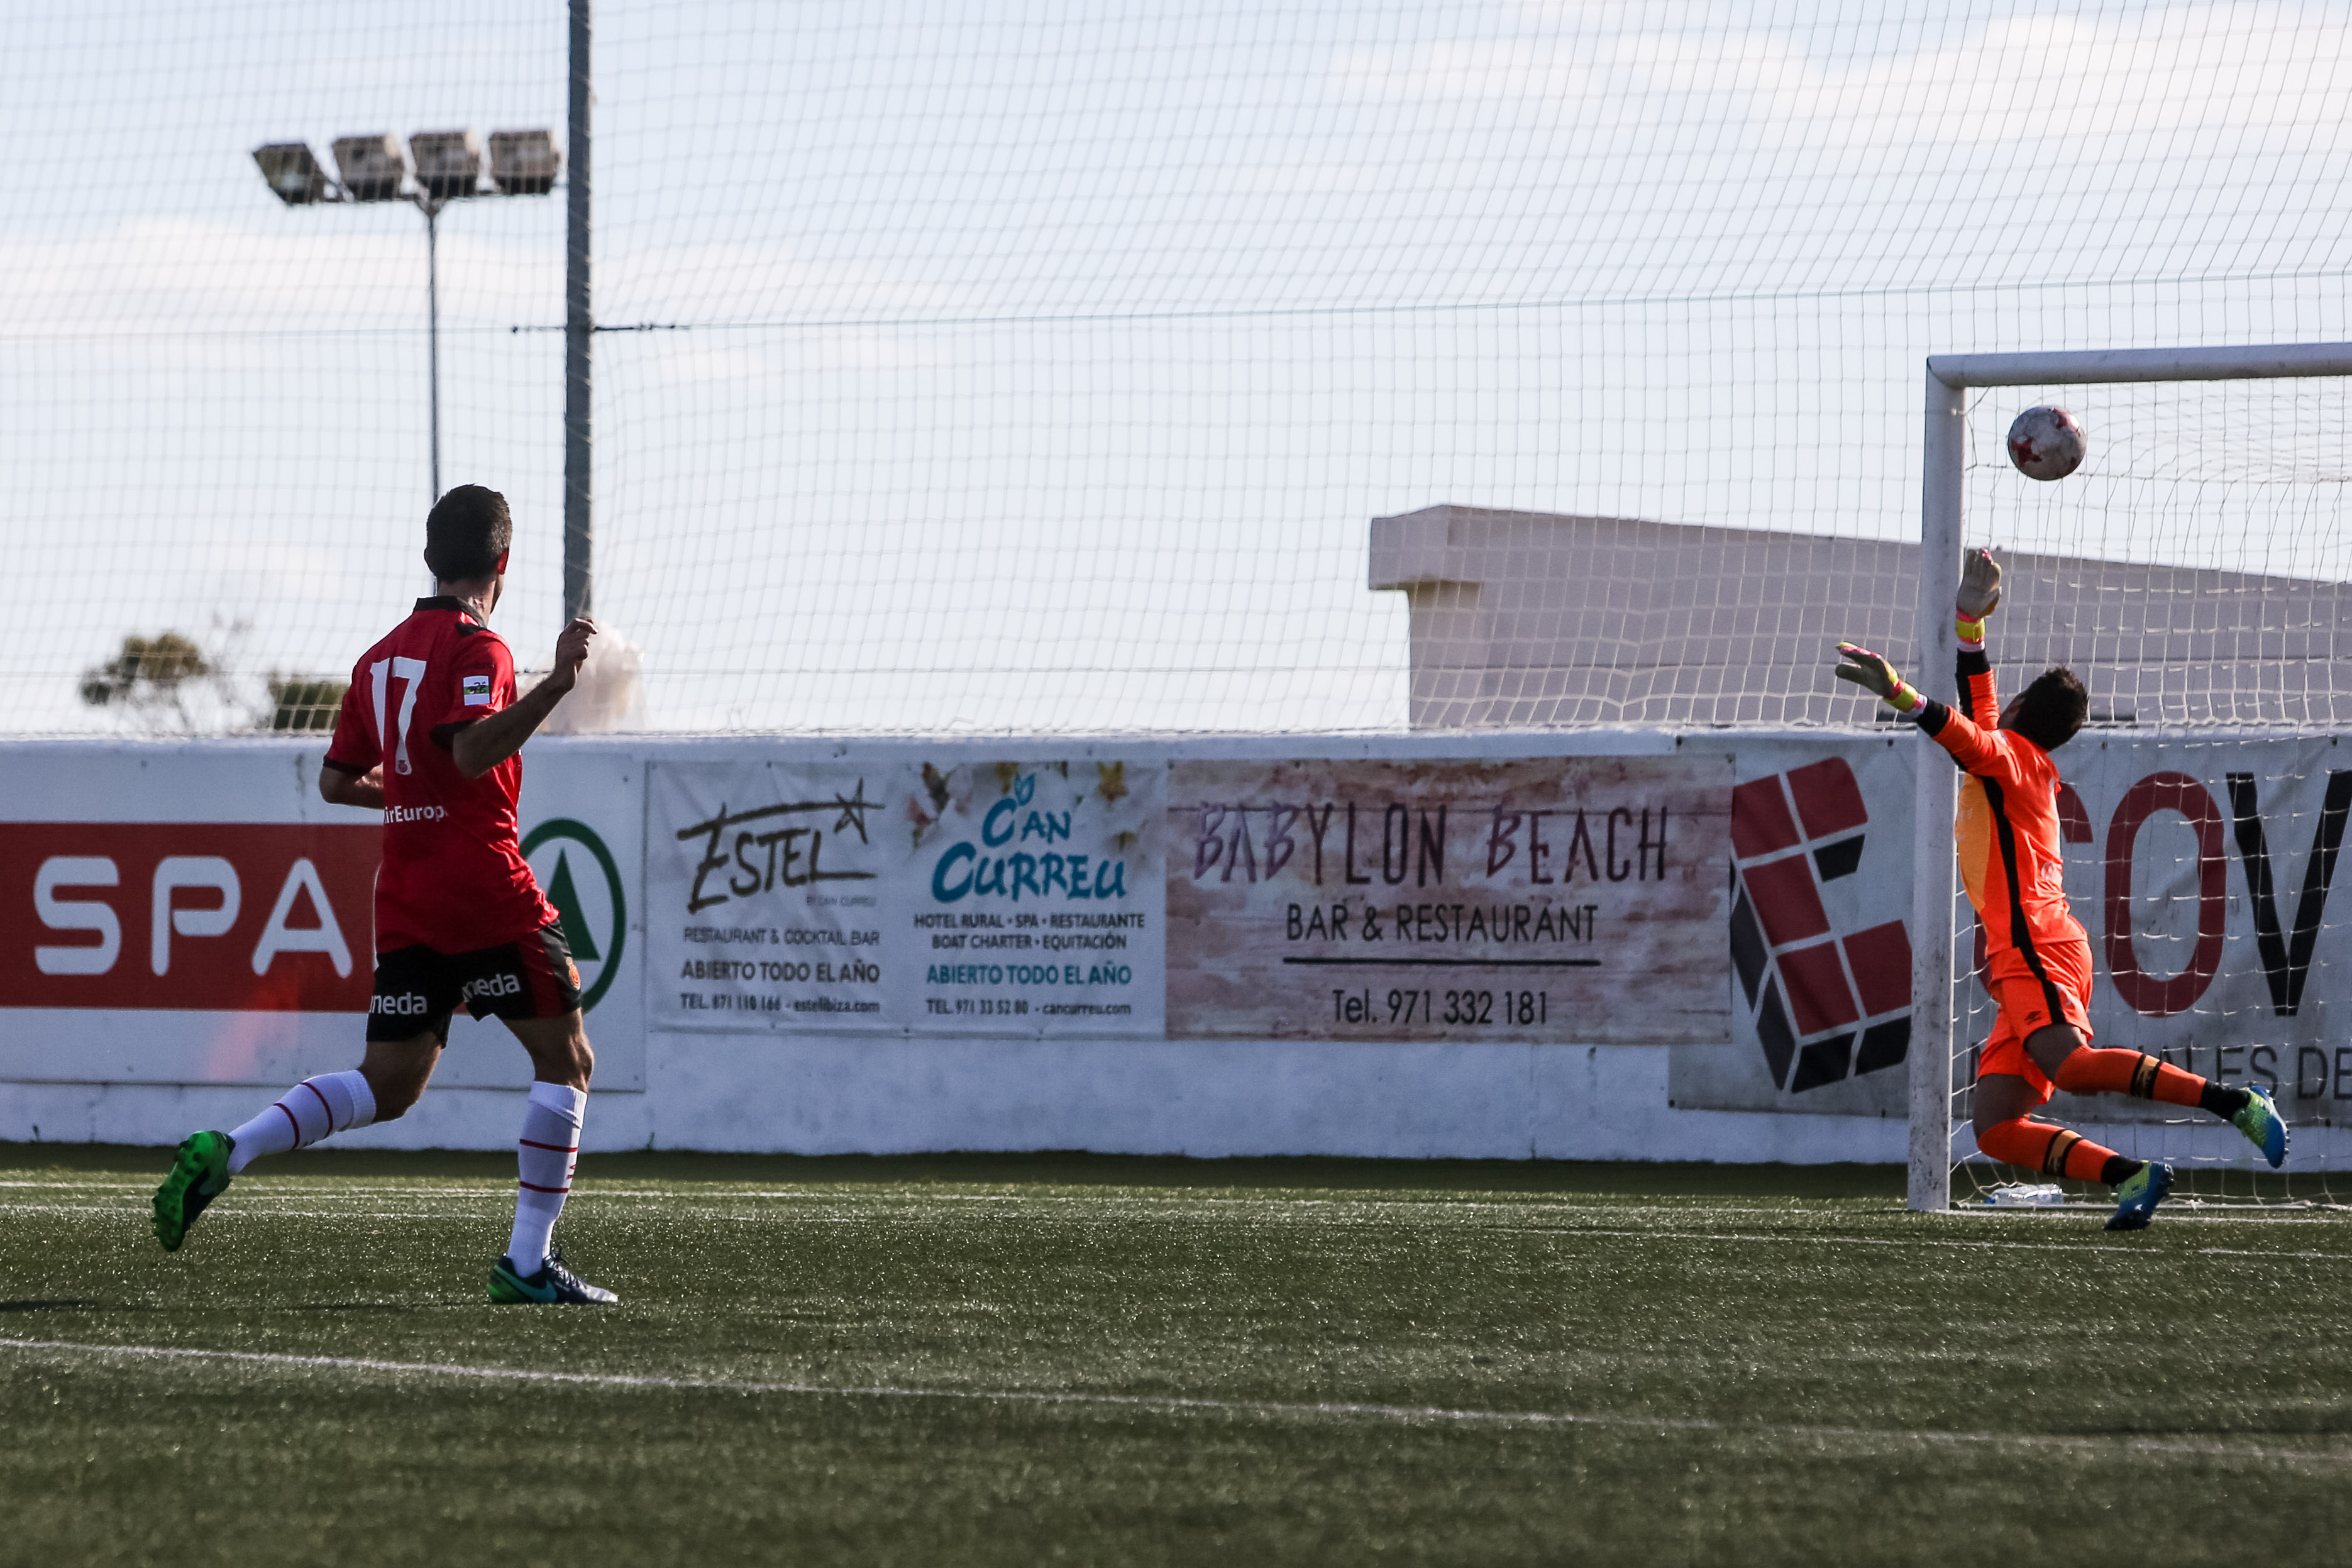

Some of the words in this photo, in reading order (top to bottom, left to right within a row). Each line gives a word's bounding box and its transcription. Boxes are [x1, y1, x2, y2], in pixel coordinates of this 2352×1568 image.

[370, 656, 427, 775] 17
[384, 804, 448, 824] irEurop
[981, 797, 1071, 847] CAN
[677, 802, 881, 915] ESTEL
[1194, 801, 1447, 888] BABYLON
[1486, 802, 1669, 885] BEACH
[931, 841, 1127, 903] CURREU
[1974, 770, 2352, 1019] OV
[33, 855, 382, 978] SPA
[914, 913, 958, 929] HOTEL
[961, 913, 1005, 929] RURAL
[1015, 913, 1039, 929] SPA
[1050, 912, 1145, 929] RESTAURANTE
[1286, 903, 1349, 942] BAR
[1361, 903, 1384, 942] &
[1396, 903, 1599, 943] RESTAURANT
[683, 926, 767, 944] RESTAURANT
[784, 928, 846, 946] COCKTAIL
[851, 929, 880, 946] BAR
[932, 933, 966, 950] BOAT
[969, 934, 1032, 950] CHARTER
[1042, 930, 1127, 951] EQUITACIÓN
[462, 973, 521, 1003] neda
[681, 959, 756, 981] ABIERTO
[759, 961, 811, 983] TODO
[816, 963, 836, 983] EL
[839, 958, 880, 983] AÑO
[926, 964, 1003, 985] ABIERTO
[1007, 964, 1059, 985] TODO
[1065, 966, 1085, 986] EL
[1088, 959, 1132, 986] AÑO
[369, 991, 428, 1015] neda
[1332, 988, 1378, 1025] Tel.
[1388, 989, 1432, 1025] 971
[1443, 990, 1494, 1025] 332
[1506, 990, 1548, 1025] 181
